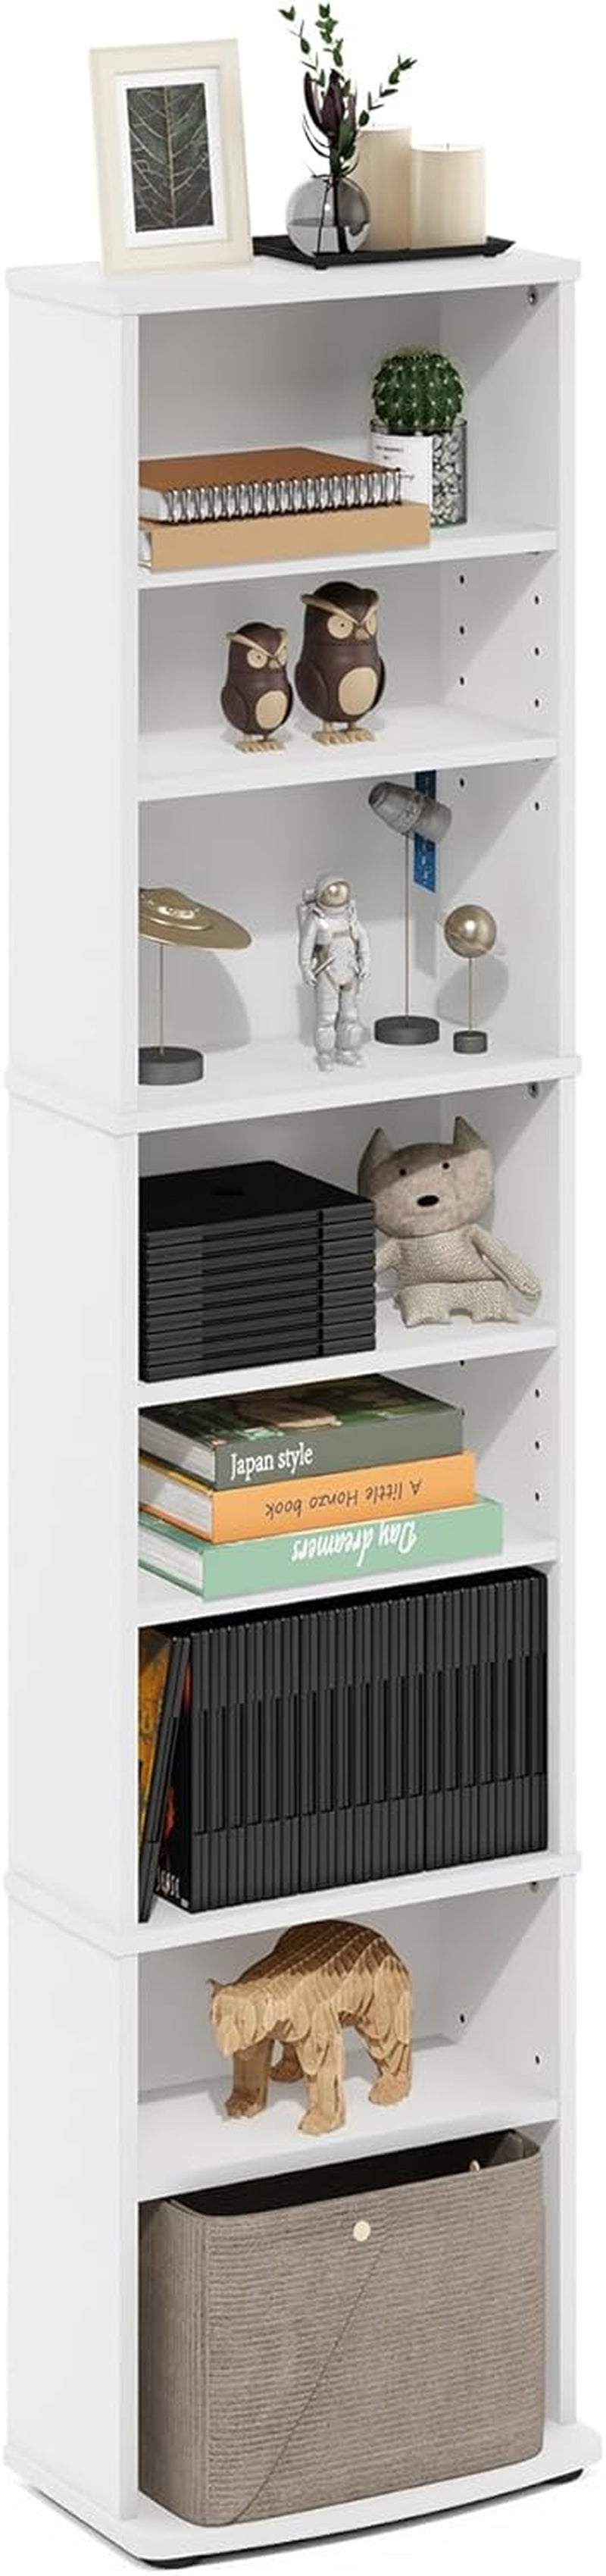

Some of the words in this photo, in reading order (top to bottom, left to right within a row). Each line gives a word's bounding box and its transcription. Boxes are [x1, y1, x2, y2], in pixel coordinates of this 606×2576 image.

[230, 1453, 275, 1481] Japan
[277, 1441, 314, 1475] style
[365, 1482, 403, 1504] little
[409, 1478, 422, 1495] A
[265, 1498, 302, 1520] book
[308, 1489, 358, 1509] Honzo
[291, 1526, 374, 1567] dreamers
[379, 1520, 417, 1554] Day
